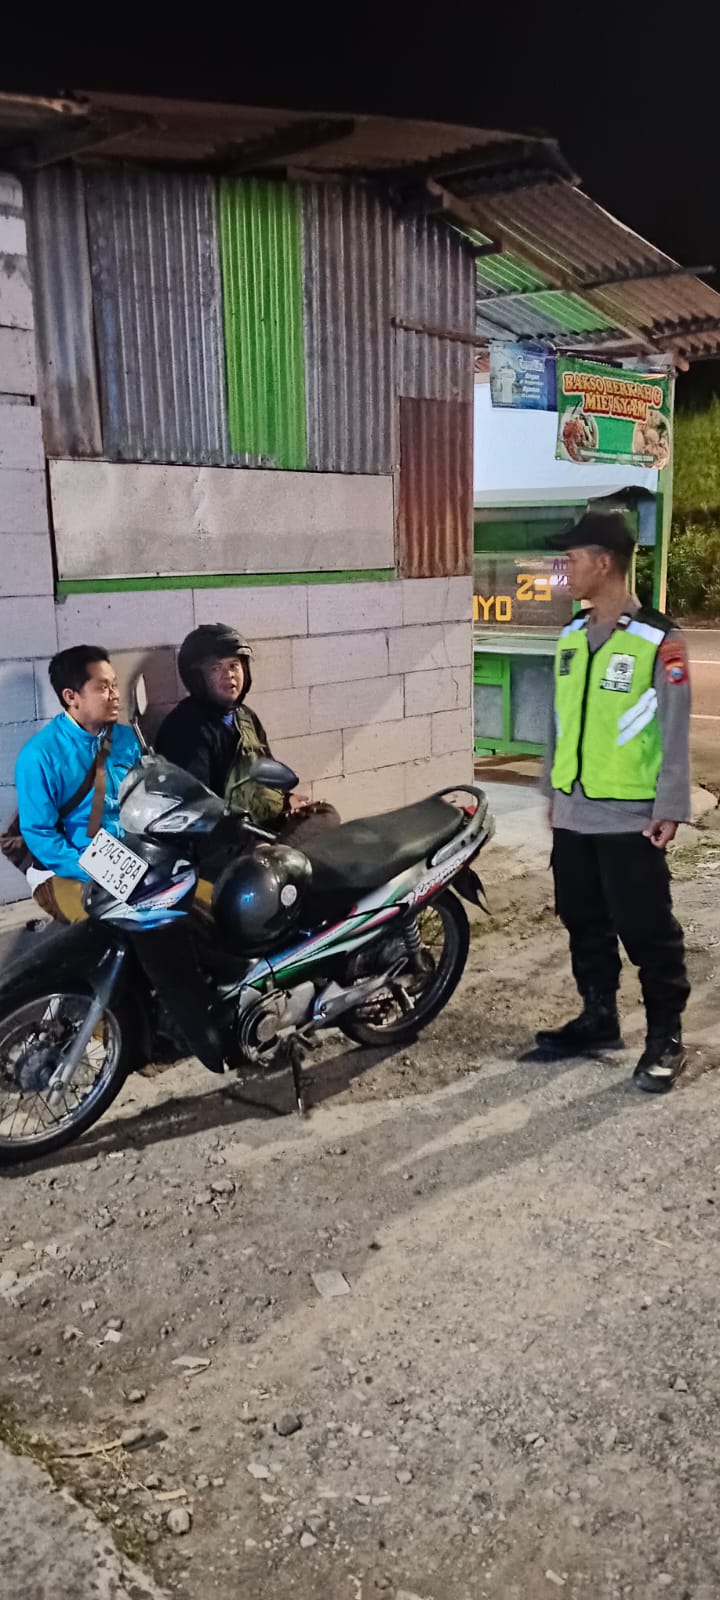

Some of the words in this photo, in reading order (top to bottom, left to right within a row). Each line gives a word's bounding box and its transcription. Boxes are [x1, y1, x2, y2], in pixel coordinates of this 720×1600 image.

[564, 373, 604, 395] BAKSO
[603, 380, 652, 404] BERKAH
[583, 393, 610, 415] MIE
[611, 397, 647, 421] AYAM
[92, 832, 103, 847] S
[98, 839, 125, 865] 2945
